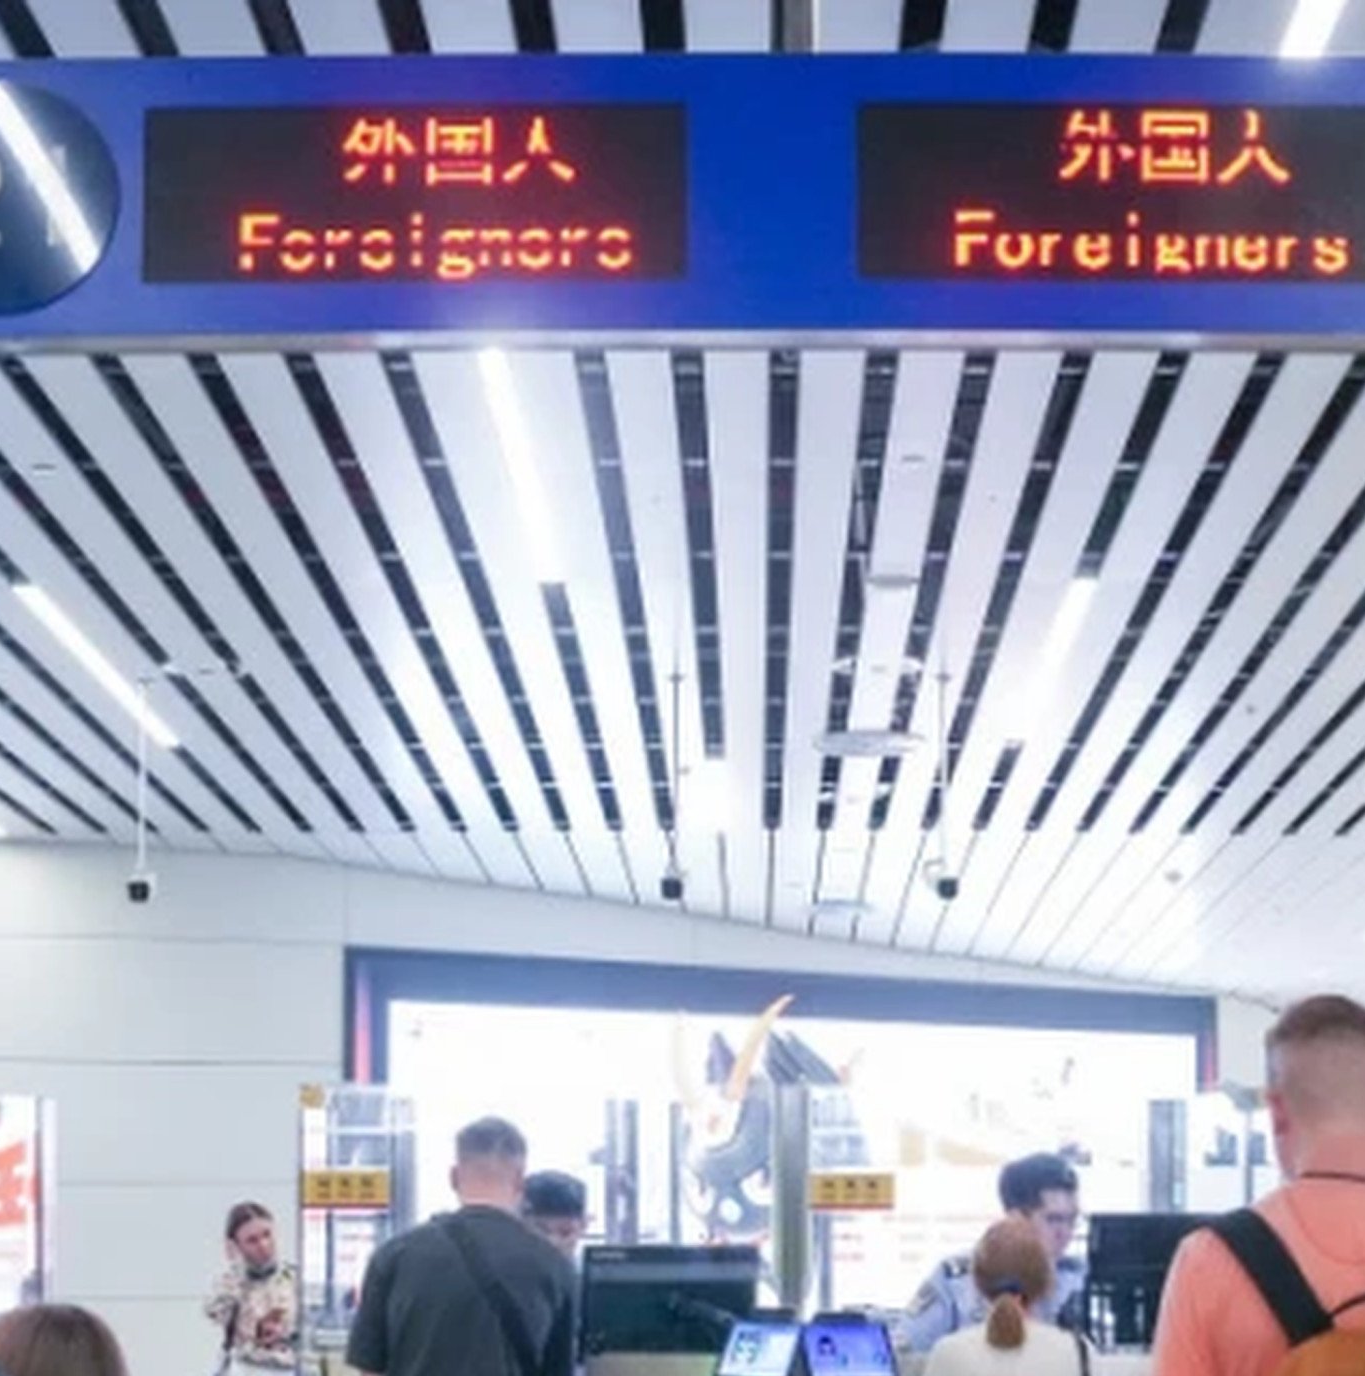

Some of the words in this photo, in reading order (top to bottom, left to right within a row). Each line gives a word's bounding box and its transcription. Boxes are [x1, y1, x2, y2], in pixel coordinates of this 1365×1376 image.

[341, 116, 577, 184] 外国人
[1057, 109, 1291, 187] 外国人
[951, 208, 1351, 275] Foreigners
